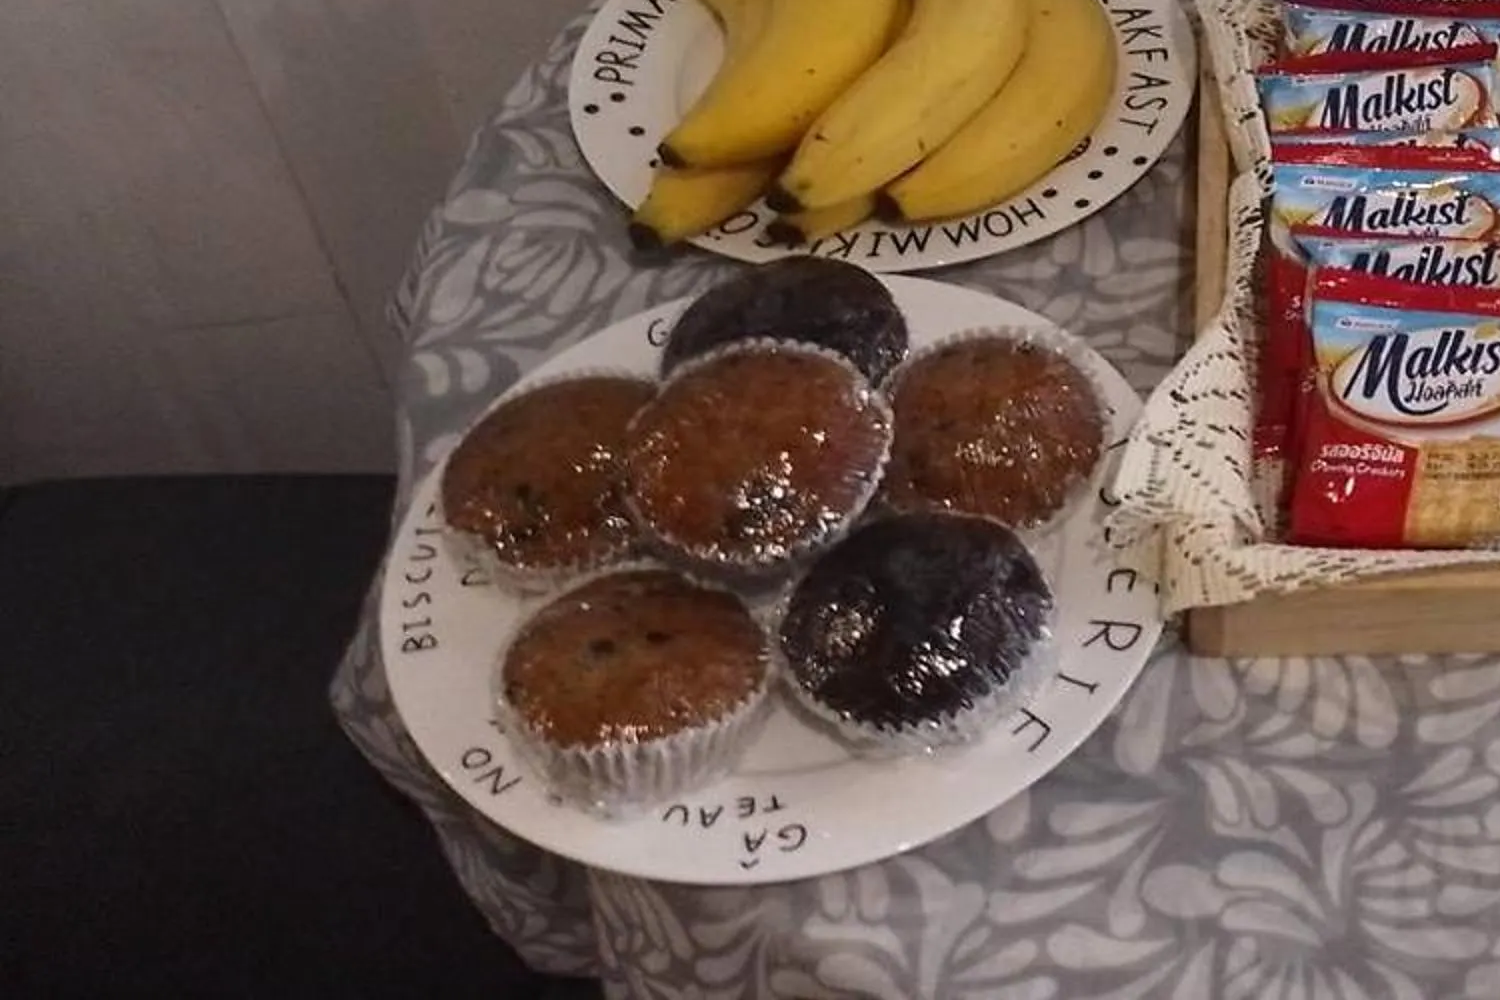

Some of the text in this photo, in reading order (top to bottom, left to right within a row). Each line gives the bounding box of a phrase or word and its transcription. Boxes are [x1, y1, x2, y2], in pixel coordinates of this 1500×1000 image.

[1319, 67, 1459, 131] Malkist
[1322, 191, 1470, 232] Malkist
[401, 501, 446, 653] BISCUI
